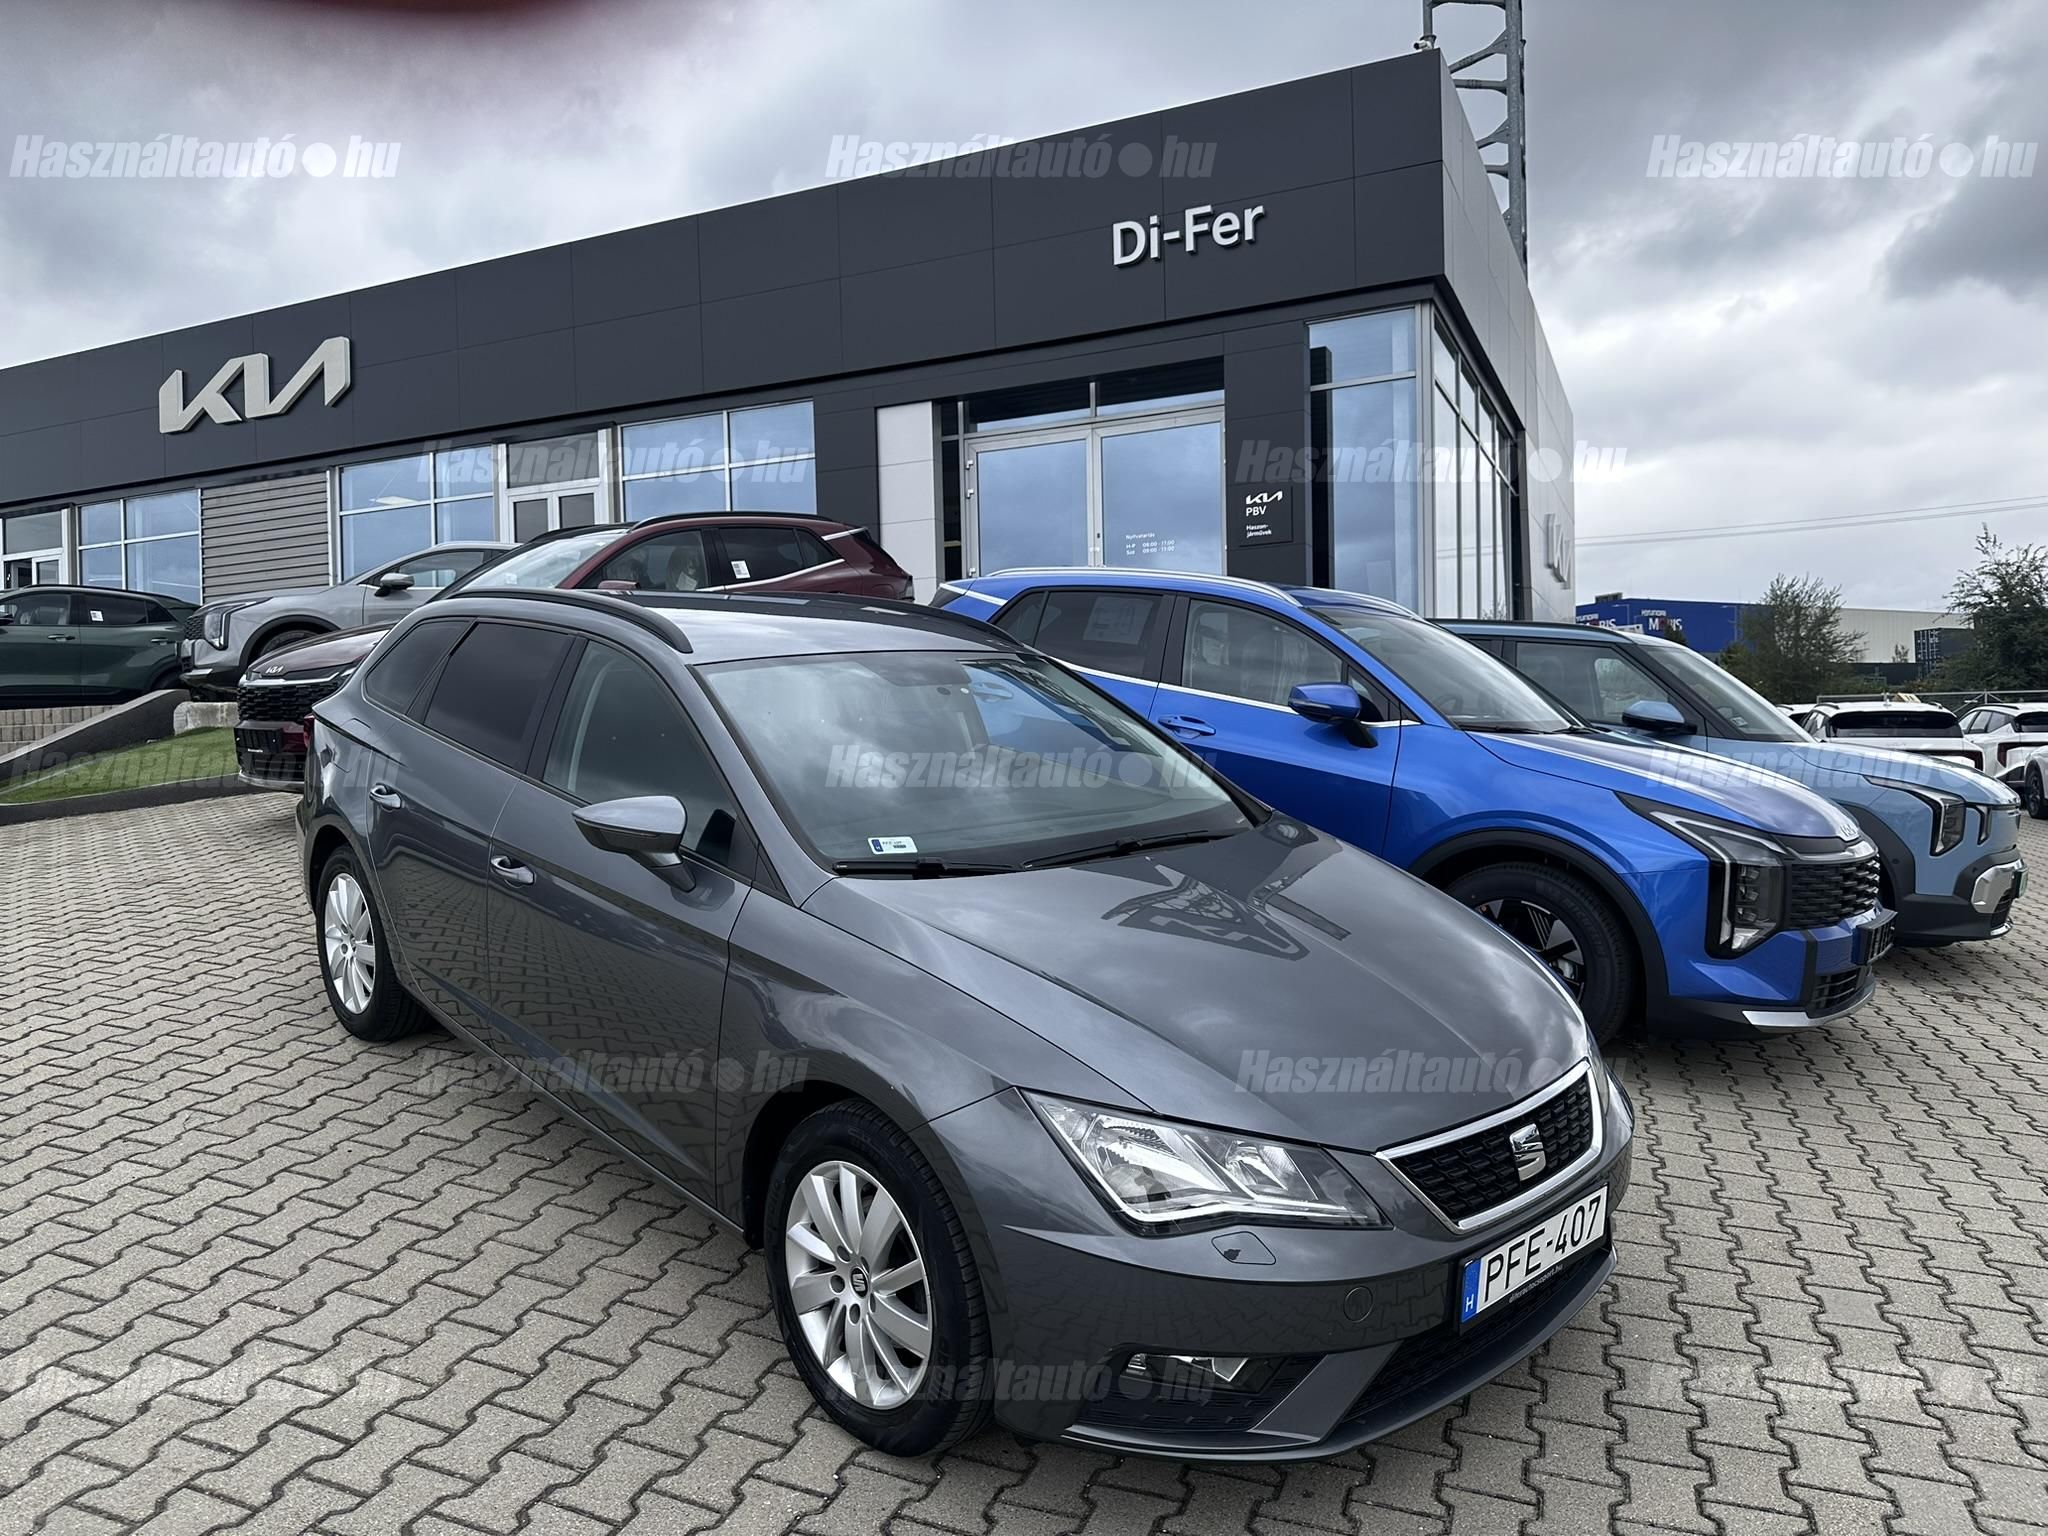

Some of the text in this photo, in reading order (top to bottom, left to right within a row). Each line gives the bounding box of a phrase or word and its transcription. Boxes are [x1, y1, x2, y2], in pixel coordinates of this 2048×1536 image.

[1113, 205, 1266, 267] Di-Fer
[159, 336, 350, 434] KIA
[1246, 505, 1267, 517] PBV
[1484, 1195, 1602, 1304] PFE-407
[1465, 1294, 1475, 1313] H
